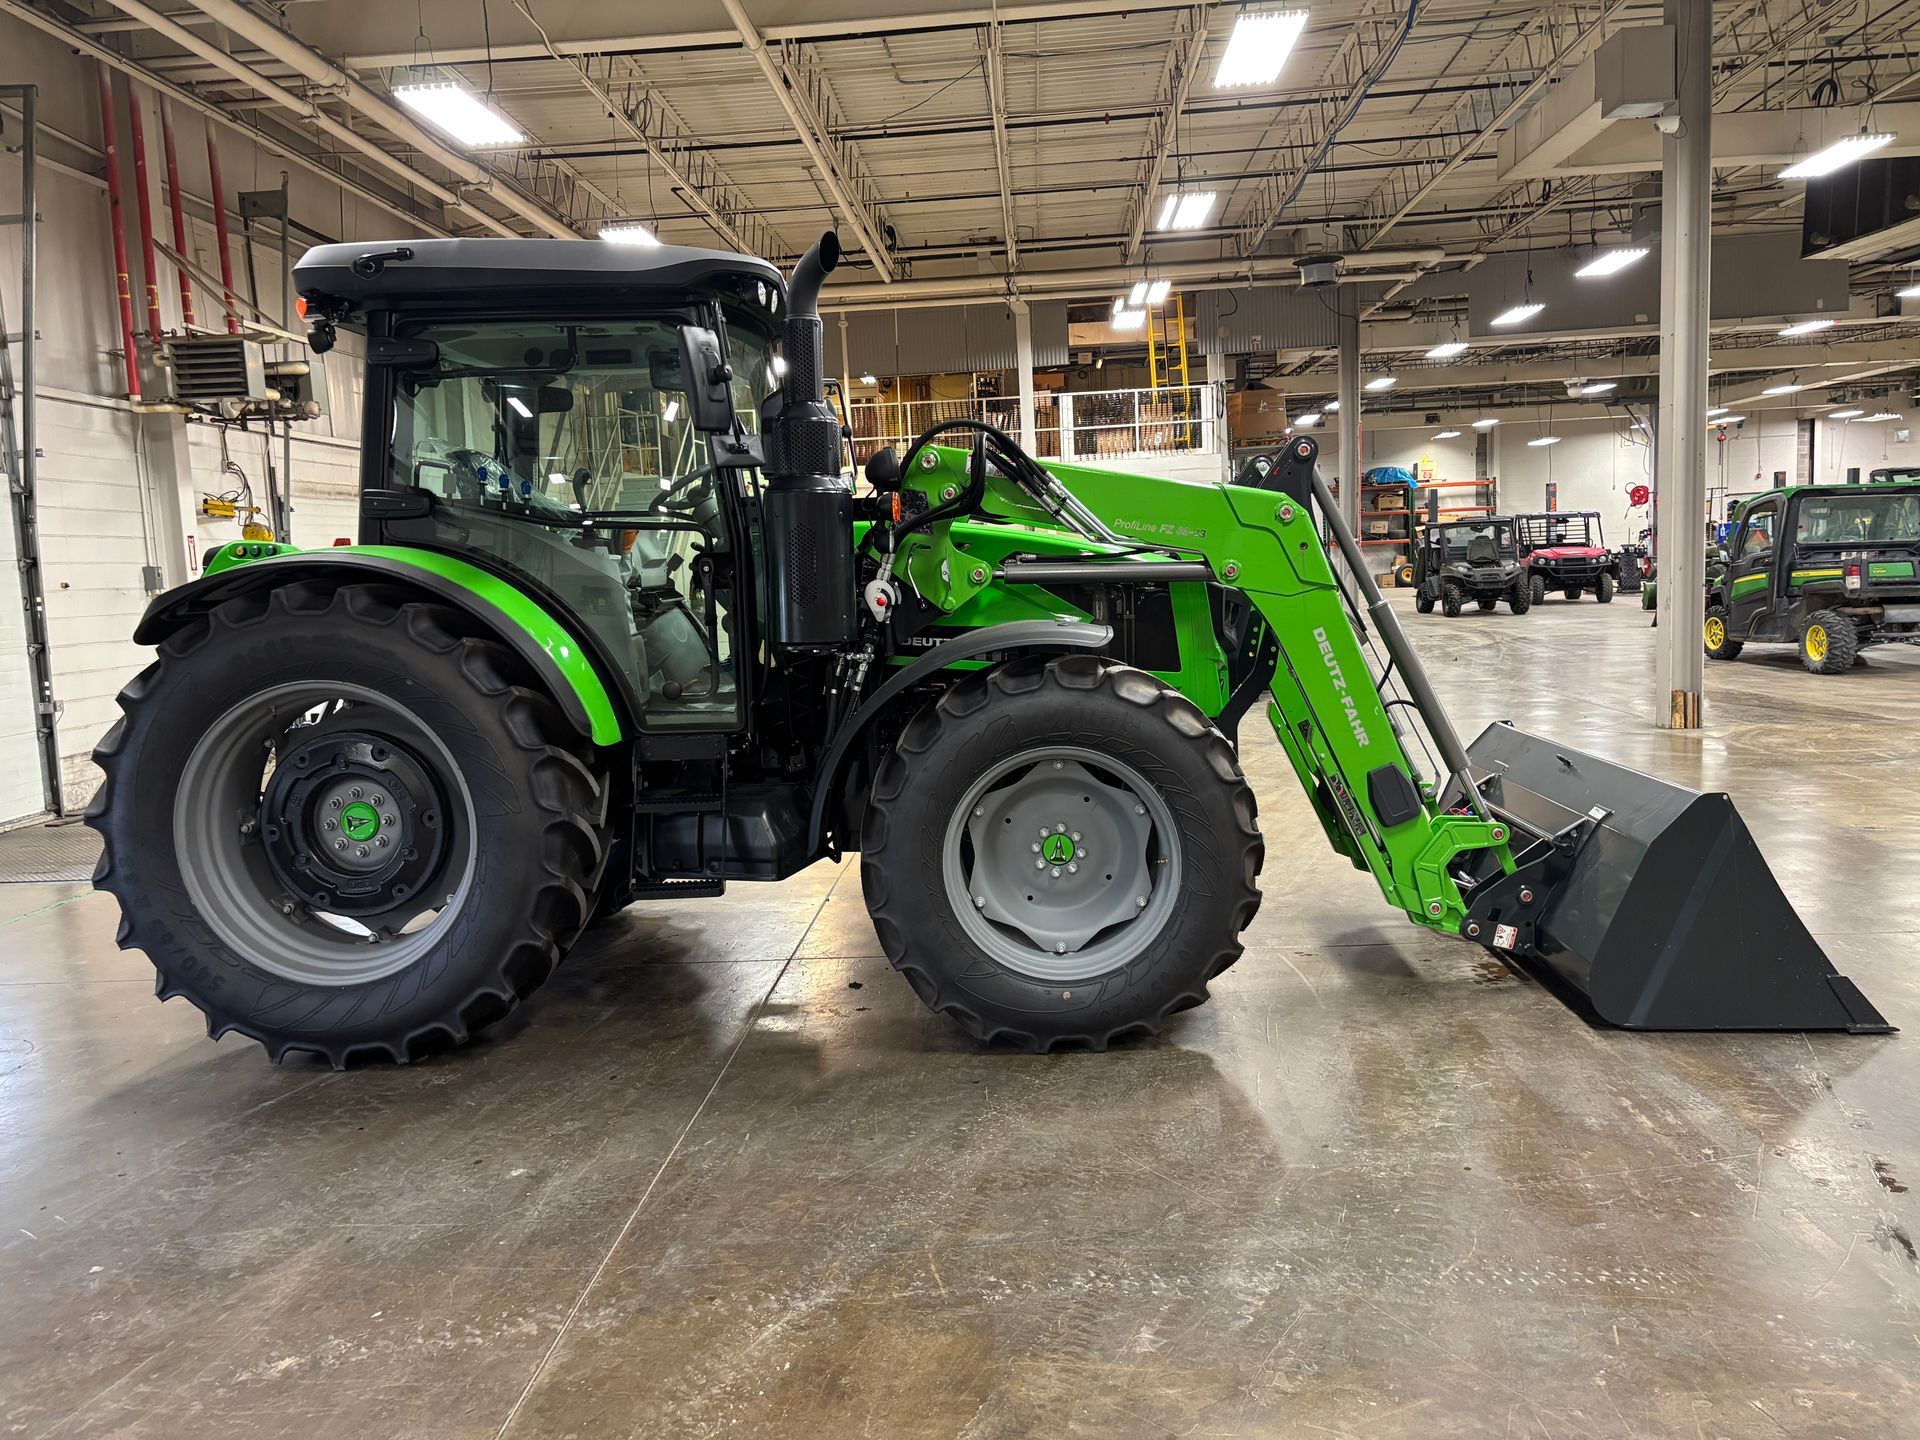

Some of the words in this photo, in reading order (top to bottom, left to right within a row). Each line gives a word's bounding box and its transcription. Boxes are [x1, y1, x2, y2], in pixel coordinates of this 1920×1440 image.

[1113, 518, 1157, 532] ProfiLine
[900, 636, 953, 647] DEUT
[1312, 626, 1369, 748] DEUTZ-FAHR
